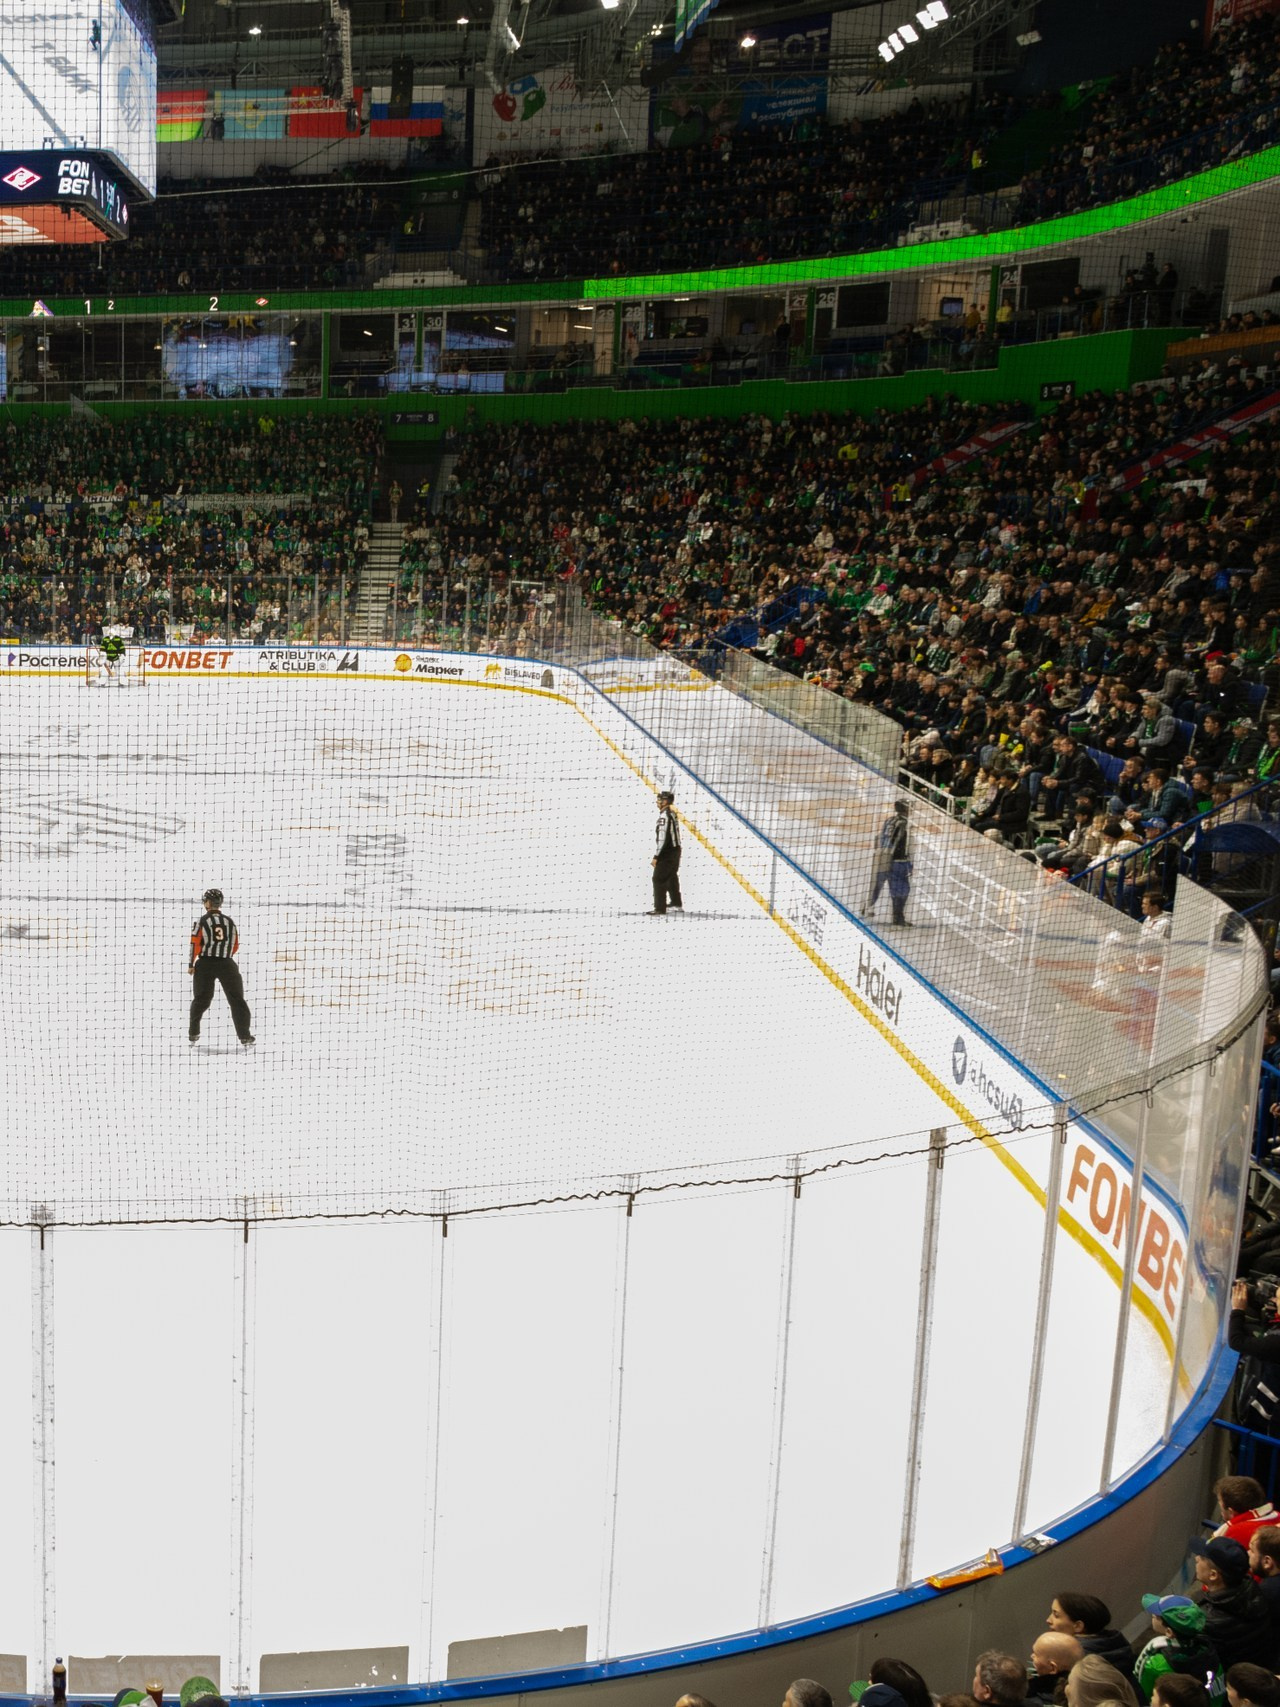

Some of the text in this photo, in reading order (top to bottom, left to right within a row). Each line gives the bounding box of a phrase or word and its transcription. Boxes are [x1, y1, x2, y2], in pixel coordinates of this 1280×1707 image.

[58, 160, 89, 178] FON
[58, 178, 90, 196] BET
[1002, 271, 1018, 284] 24
[209, 296, 219, 311] 2
[819, 292, 835, 304] 26
[84, 300, 91, 315] 1
[108, 301, 115, 311] 2
[624, 306, 641, 318] 28
[402, 319, 417, 329] 31
[426, 317, 442, 327] 30
[396, 414, 402, 423] 7
[18, 652, 101, 668] Ростелек
[138, 650, 233, 669] FONBET
[260, 651, 336, 661] ATRIBUTIKA
[269, 661, 278, 670] &
[282, 661, 316, 671] CLUB
[415, 664, 464, 676] Маркет
[504, 667, 541, 681] GISLAVED
[856, 943, 902, 1026] Haier
